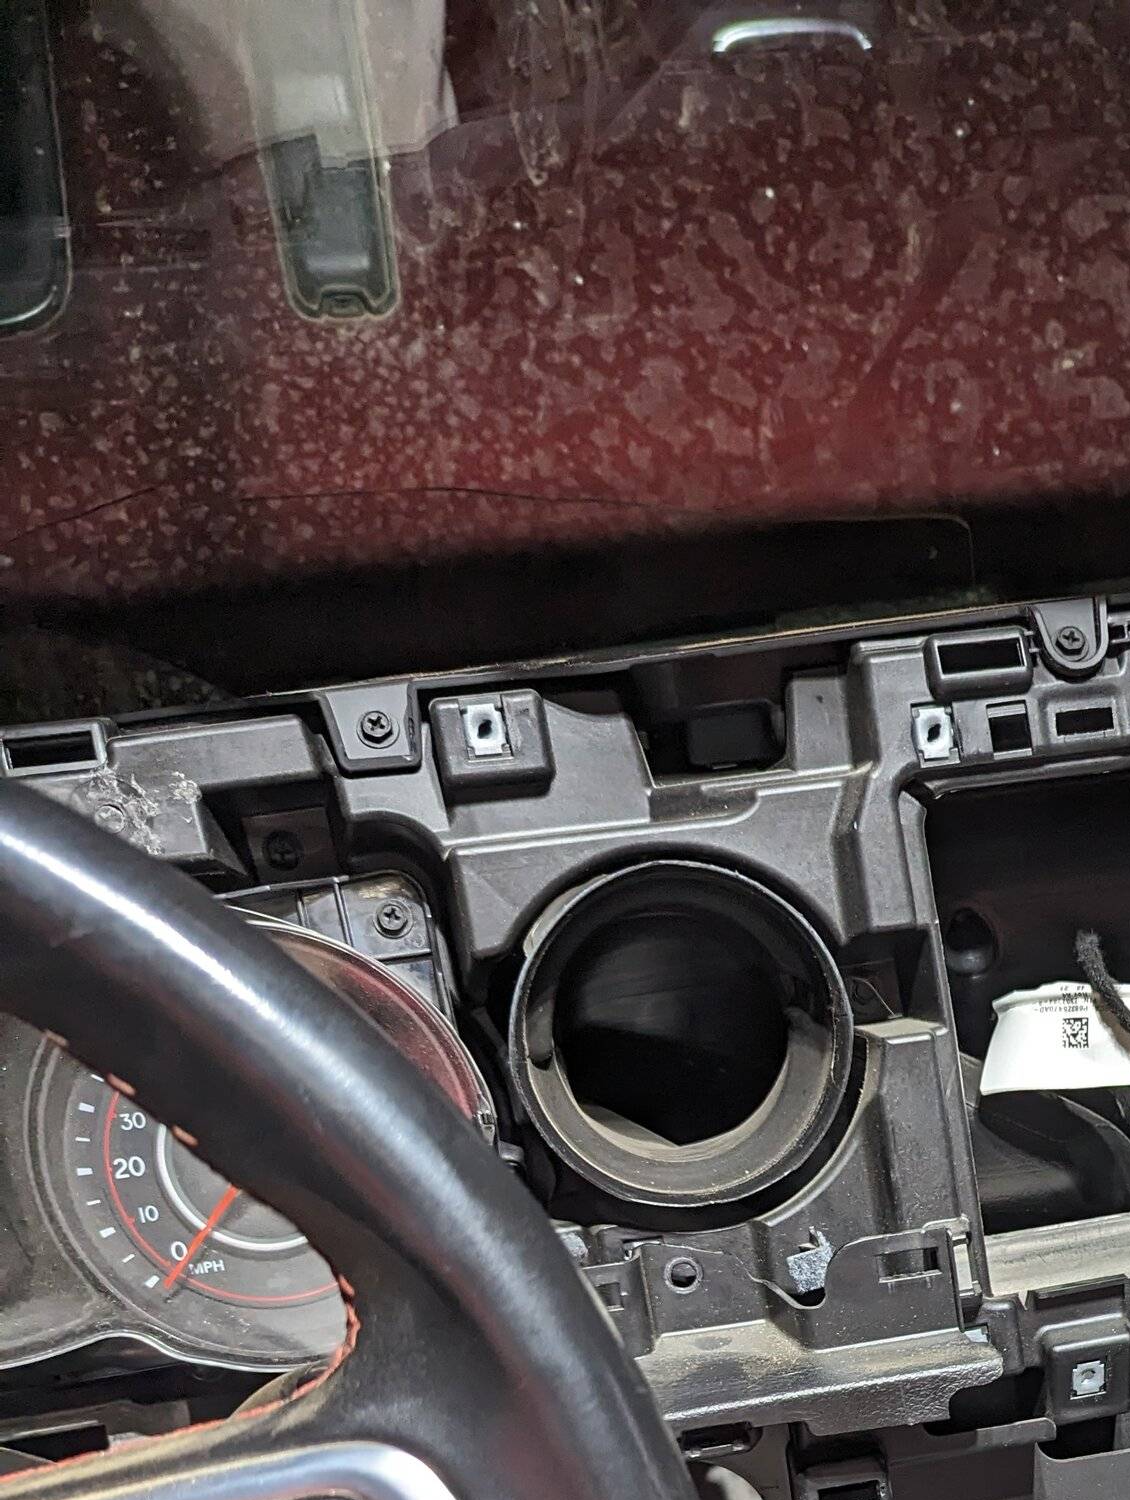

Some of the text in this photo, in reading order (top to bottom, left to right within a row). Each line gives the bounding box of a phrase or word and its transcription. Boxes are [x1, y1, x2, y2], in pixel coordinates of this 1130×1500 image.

[119, 1111, 147, 1131] 30
[112, 1155, 146, 1180] 20
[138, 1205, 160, 1224] 10
[170, 1240, 189, 1262] 0
[189, 1260, 225, 1276] MPH
